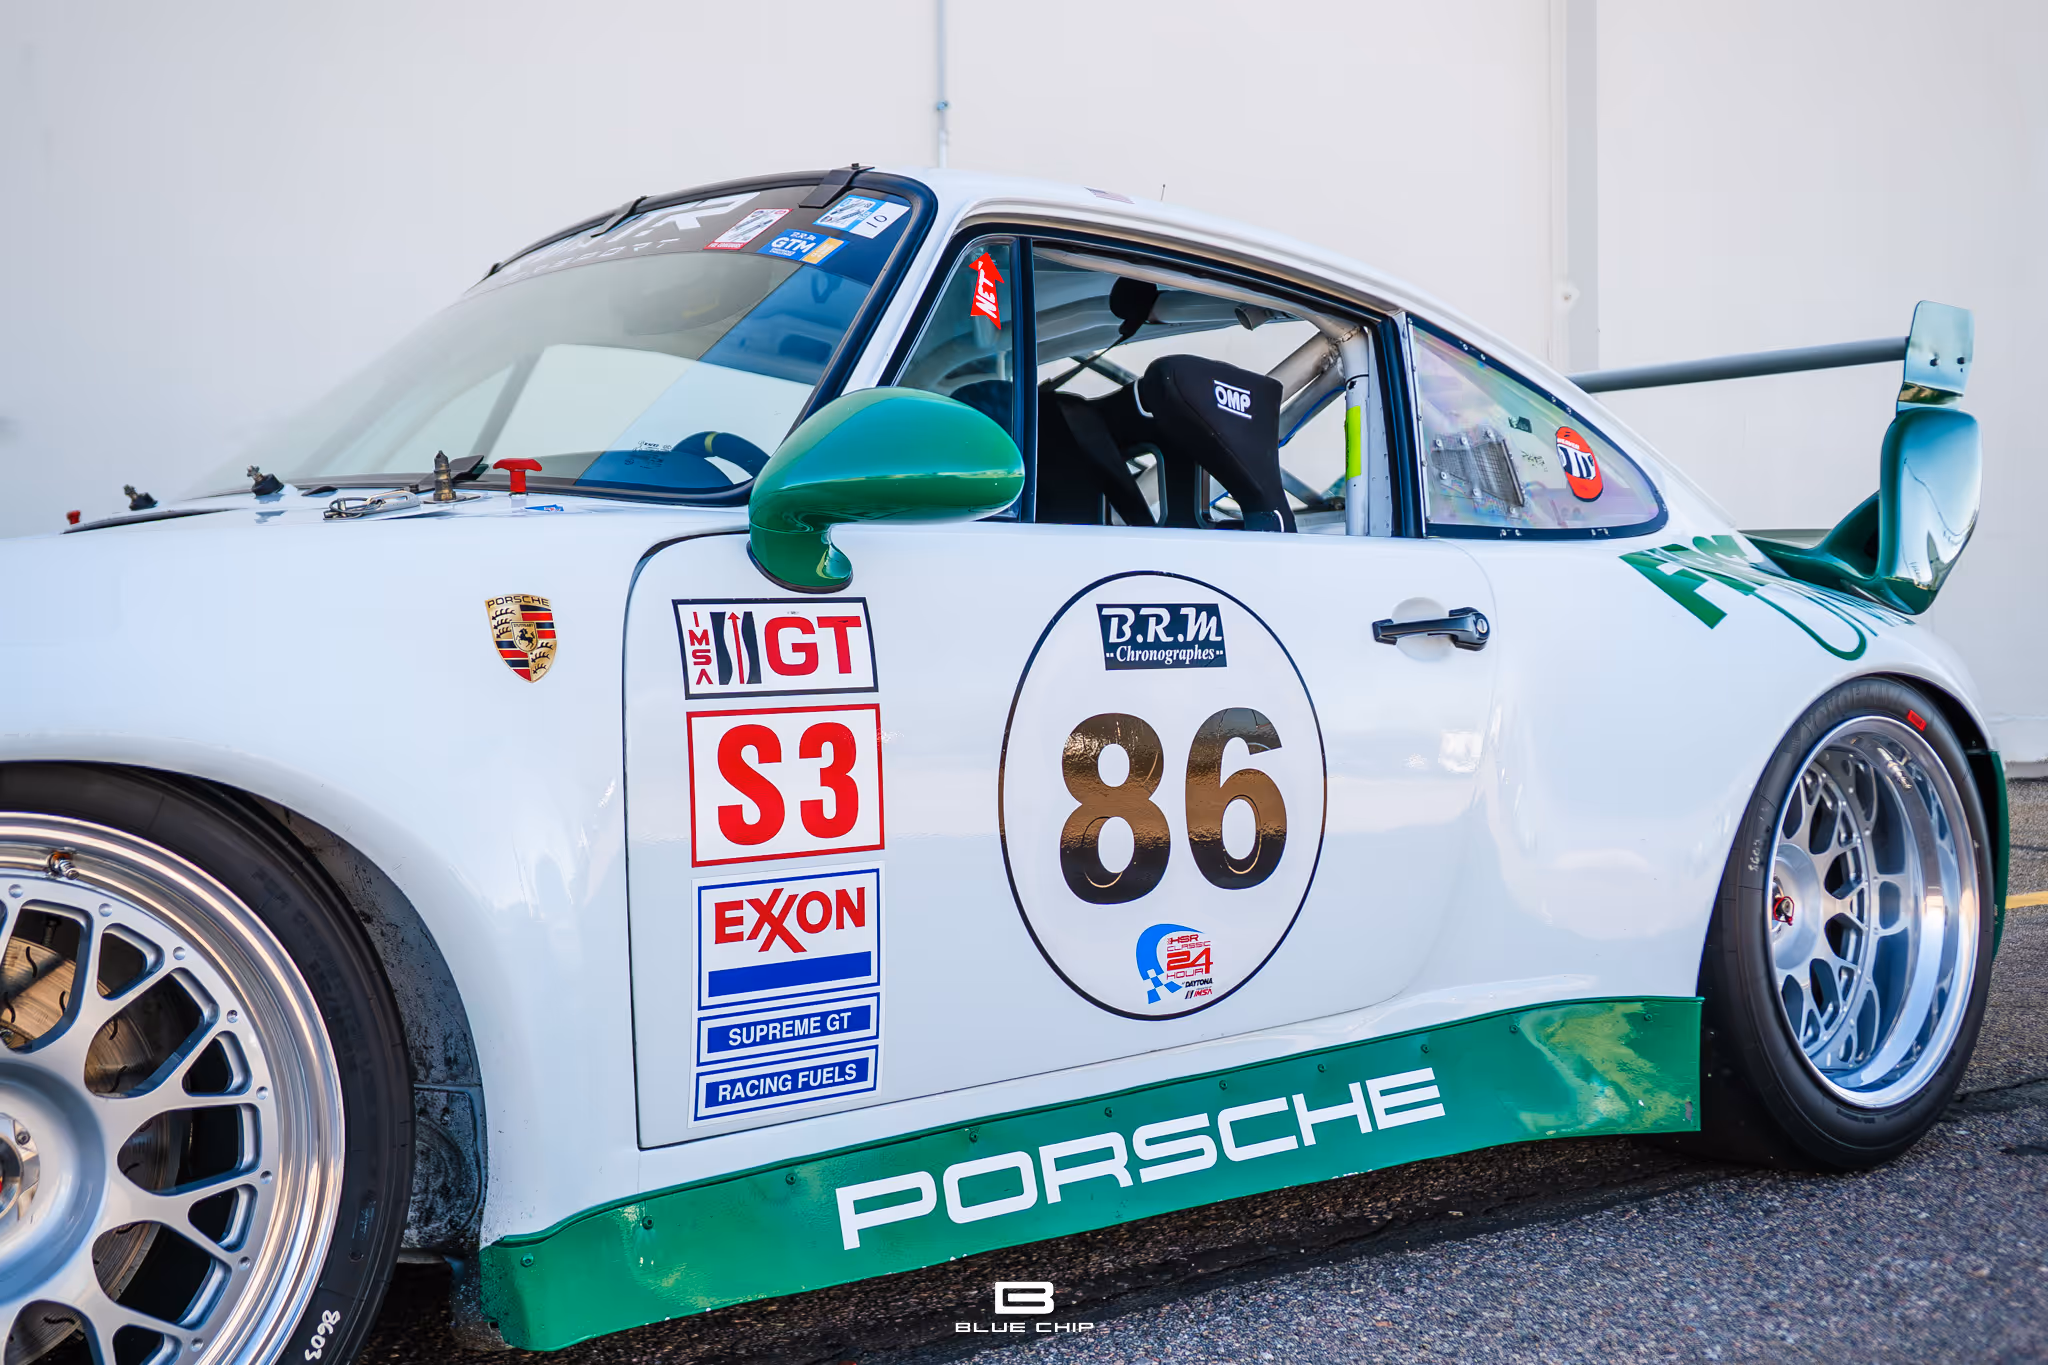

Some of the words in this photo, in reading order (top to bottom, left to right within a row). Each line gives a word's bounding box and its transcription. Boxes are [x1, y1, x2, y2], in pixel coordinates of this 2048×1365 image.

[771, 236, 816, 253] GTM
[975, 268, 998, 319] NET
[1215, 385, 1251, 412] OMP
[487, 595, 550, 609] PORSCHE
[688, 611, 714, 685] IMSA
[764, 615, 862, 677] GT
[1116, 644, 1215, 665] Chronographes
[717, 721, 859, 846] S3
[1060, 707, 1287, 905] 86
[714, 886, 866, 953] EXXON
[1167, 940, 1211, 952] CLASSIC
[1170, 934, 1199, 944] HSR
[1166, 947, 1214, 974] 24
[1166, 967, 1204, 980] HOUR
[1184, 978, 1213, 988] DAYTONA
[728, 1016, 821, 1046] SUPREME
[826, 1012, 852, 1031] GT
[718, 1074, 792, 1102] RACING
[798, 1063, 857, 1089] FUELS
[835, 1067, 1446, 1250] PORSCHE
